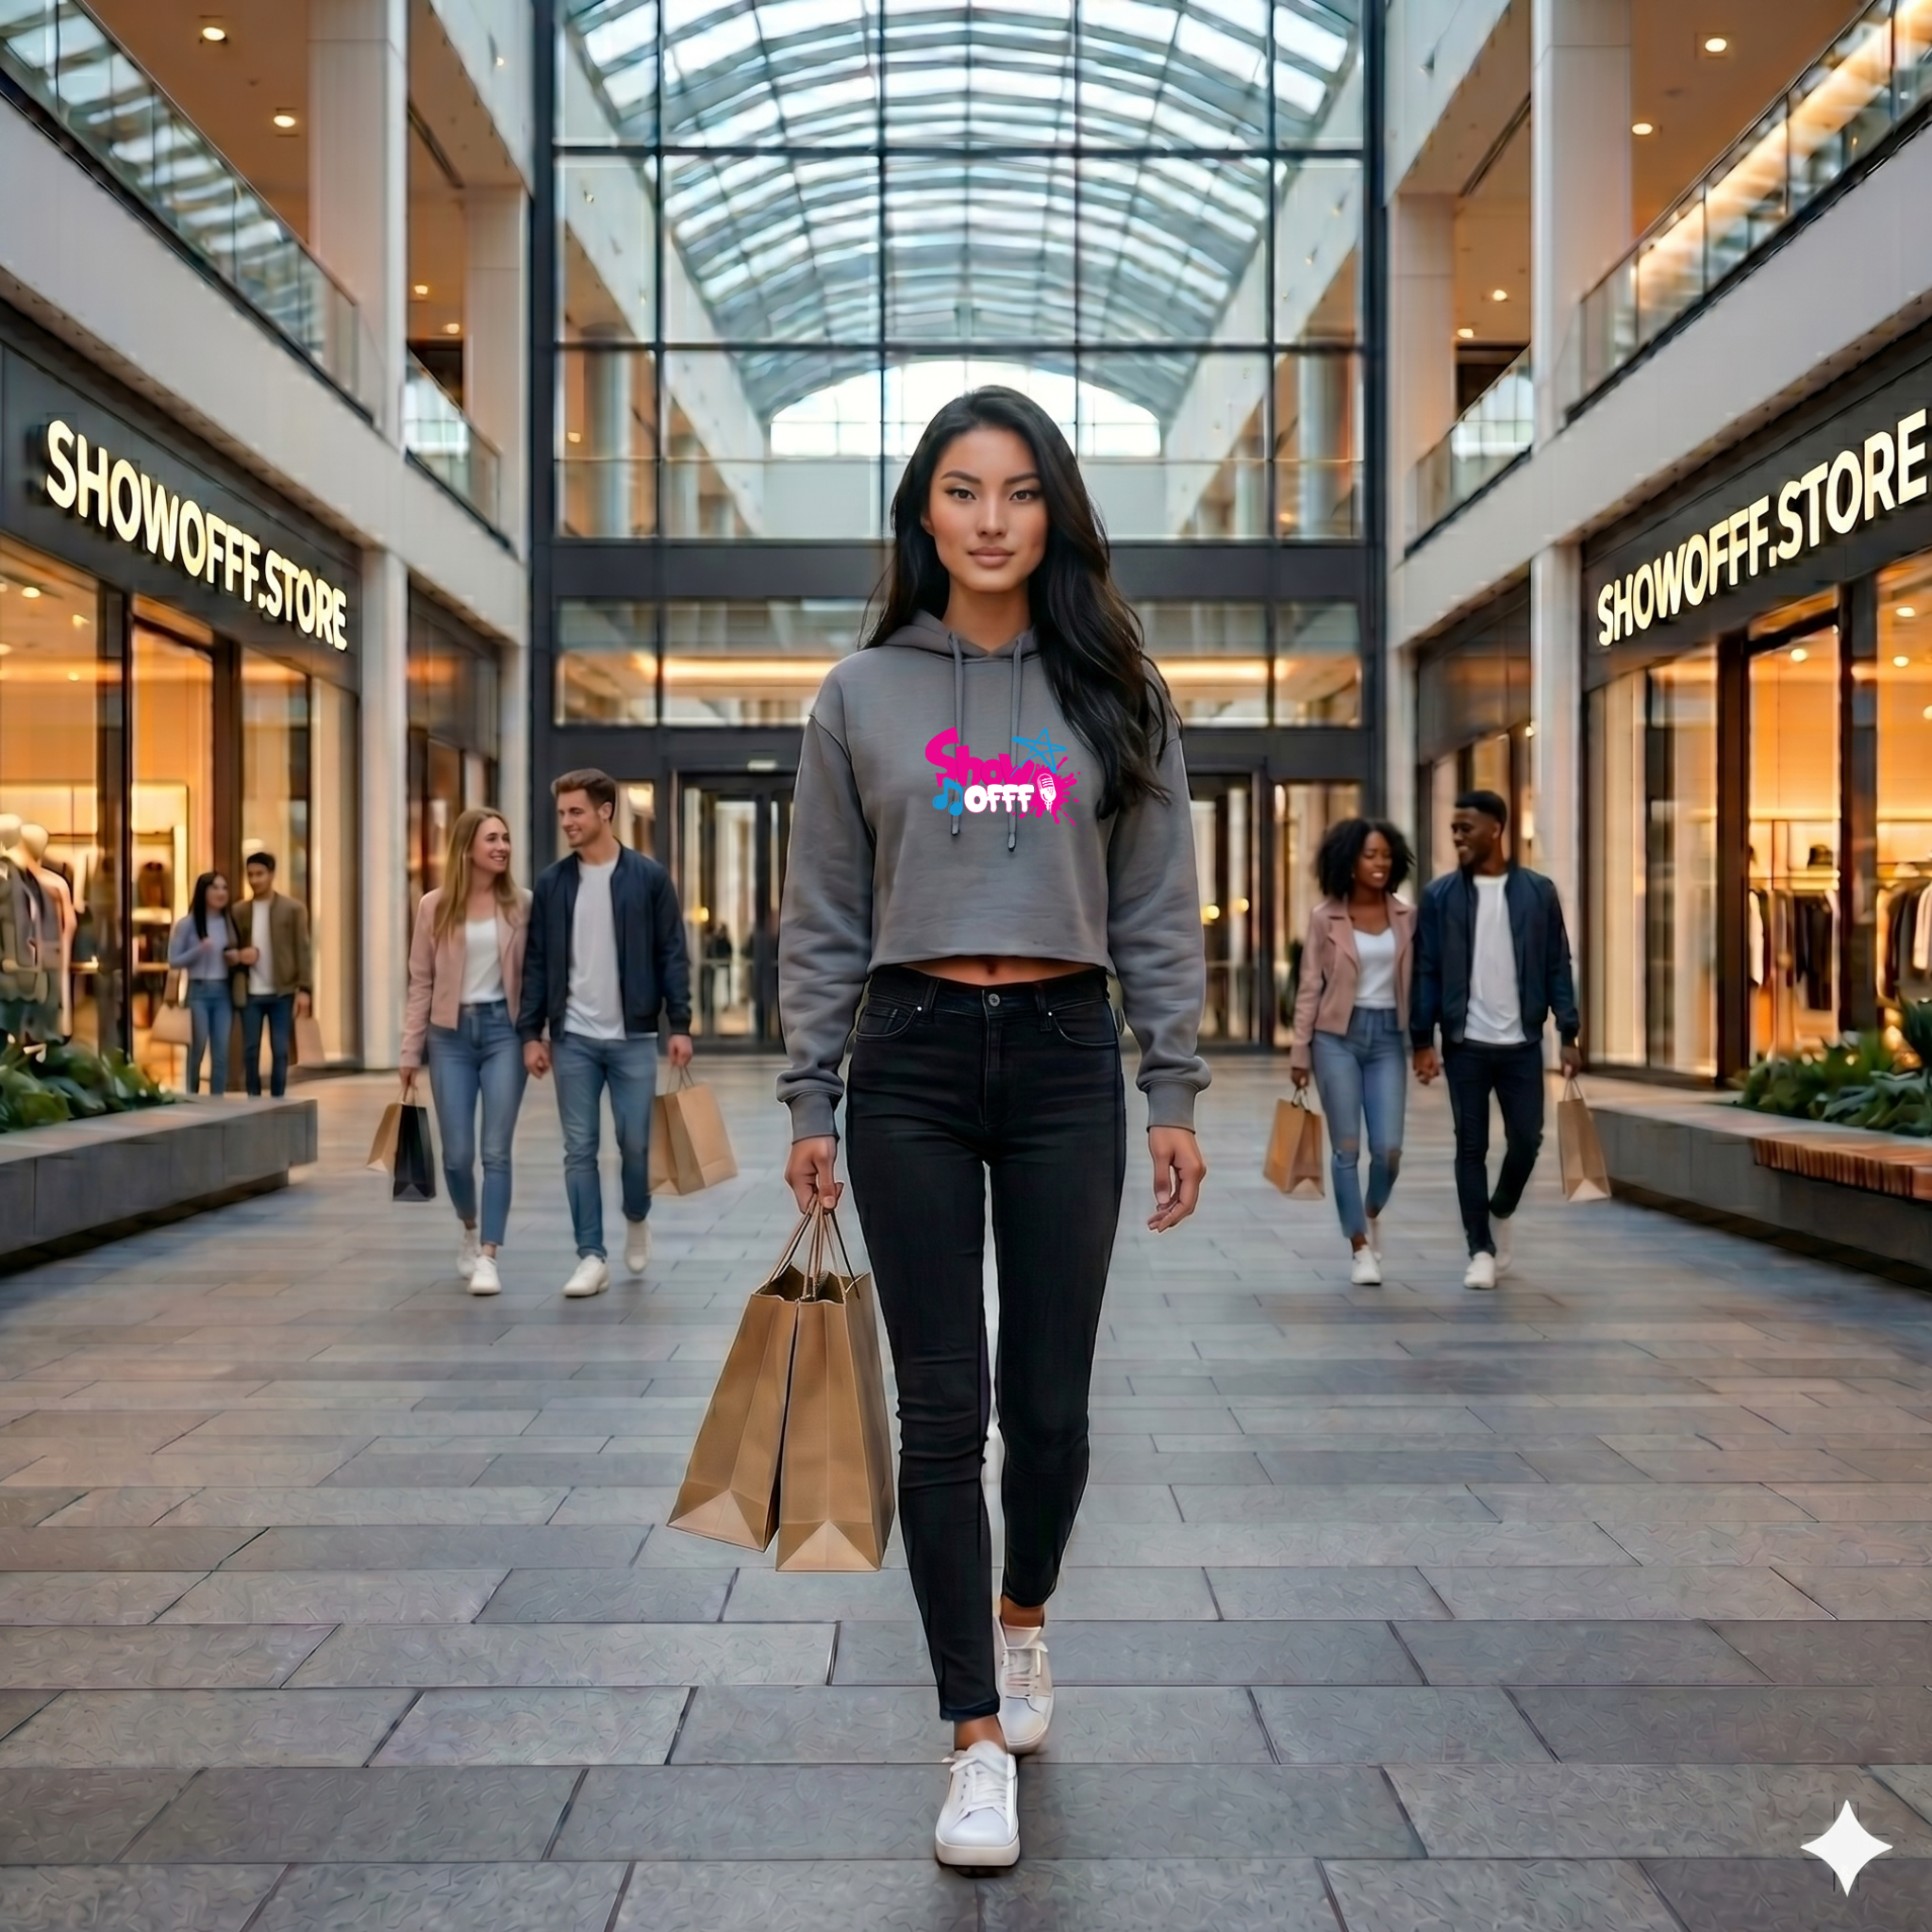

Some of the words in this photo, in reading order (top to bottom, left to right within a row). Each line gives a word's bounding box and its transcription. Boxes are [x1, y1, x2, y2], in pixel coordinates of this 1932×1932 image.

[47, 420, 347, 651] SHOWOFFF.STORE
[1597, 408, 1927, 646] SHOWOFFF.STORE
[925, 726, 1035, 787] Show
